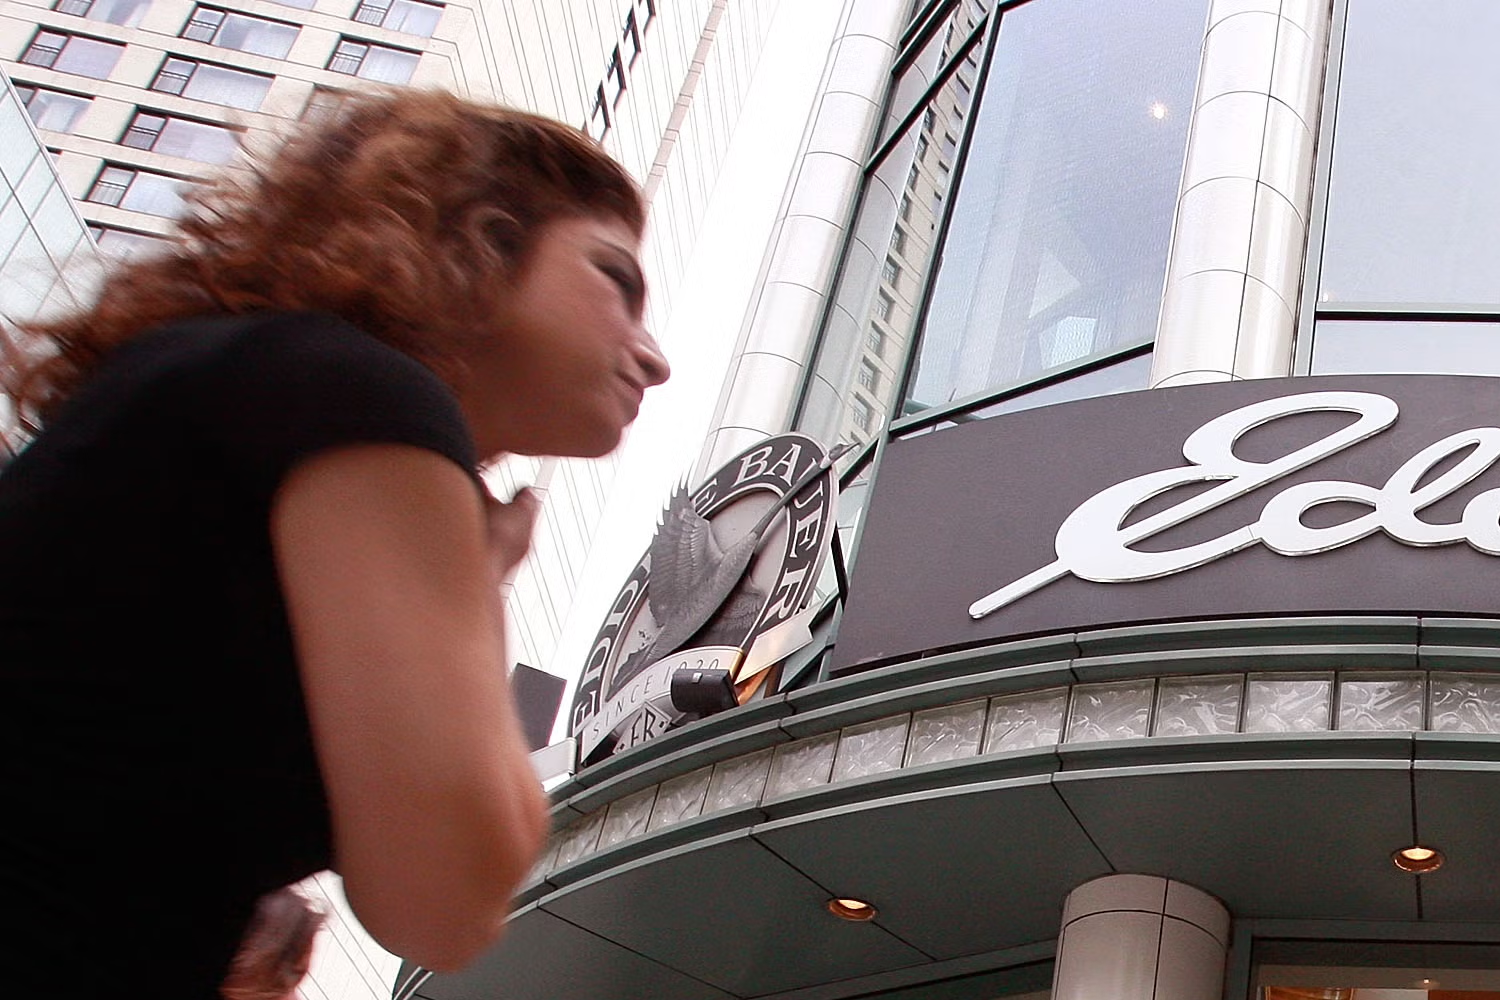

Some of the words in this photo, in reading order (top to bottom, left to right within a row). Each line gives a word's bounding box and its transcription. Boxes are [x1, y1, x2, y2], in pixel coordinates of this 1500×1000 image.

[573, 478, 719, 738] EDDE
[730, 442, 825, 628] BAUER
[591, 673, 654, 742] SINCE
